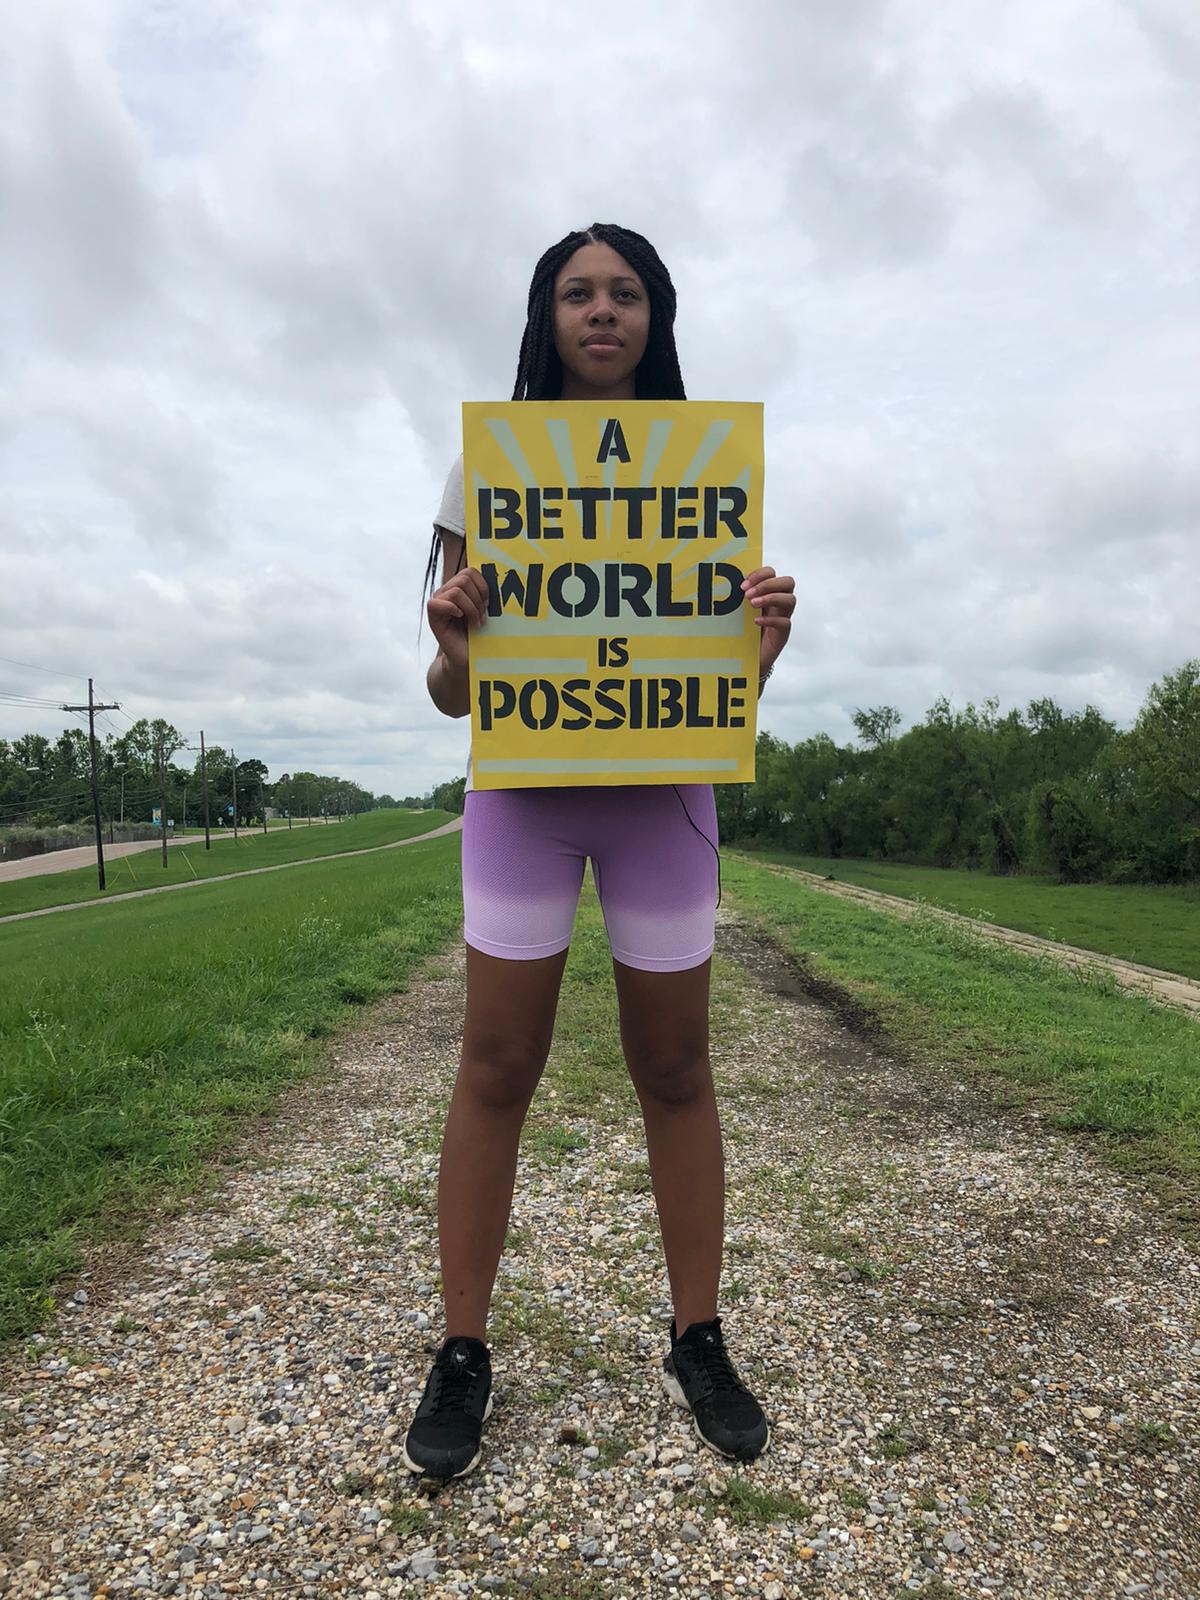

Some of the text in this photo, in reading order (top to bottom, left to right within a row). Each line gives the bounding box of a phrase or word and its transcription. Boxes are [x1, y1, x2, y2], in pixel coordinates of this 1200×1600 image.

[597, 419, 631, 463] A
[478, 487, 747, 539] BETTER
[481, 562, 745, 618] WORLD
[598, 638, 629, 667] IS
[479, 677, 747, 731] POSSIBLE
